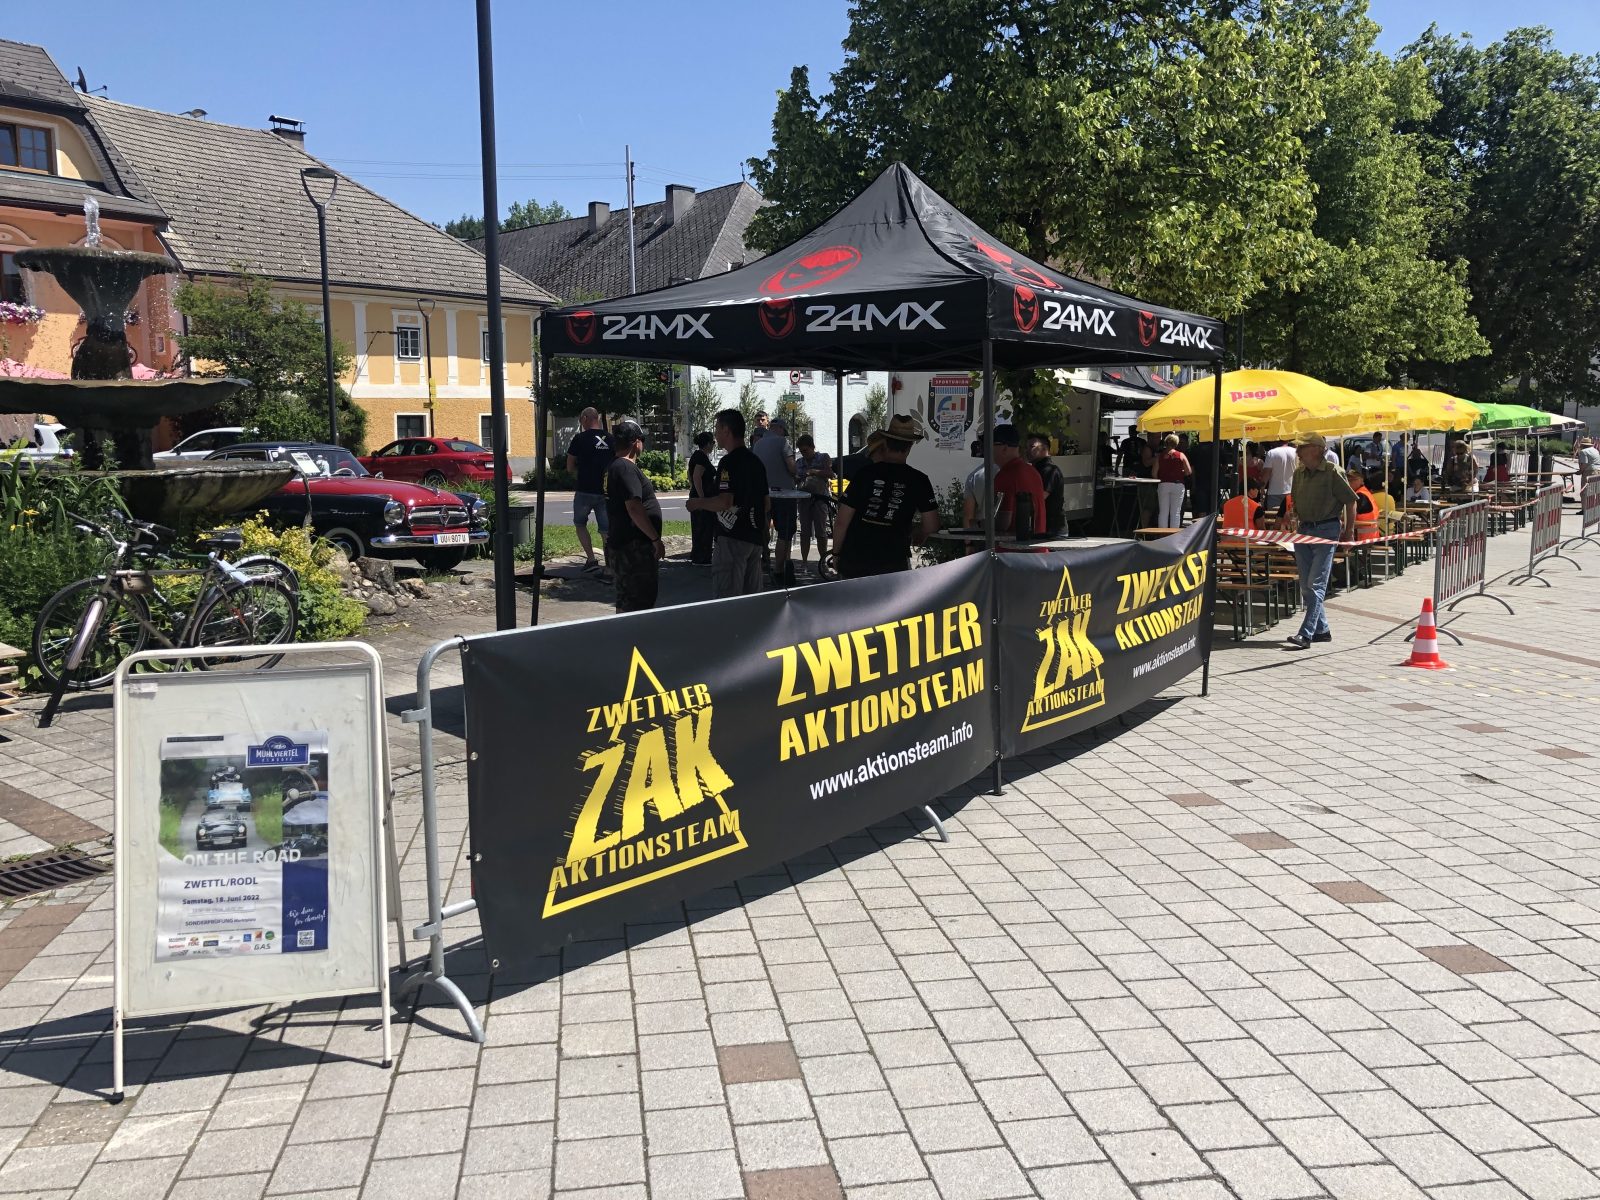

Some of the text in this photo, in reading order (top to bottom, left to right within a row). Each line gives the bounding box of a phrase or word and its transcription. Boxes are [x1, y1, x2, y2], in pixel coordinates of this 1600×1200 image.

[602, 312, 714, 341] 24MX
[805, 300, 947, 332] 24MX
[1042, 300, 1117, 337] 24MX
[1160, 319, 1214, 350] 24MX
[1229, 389, 1278, 403] pago
[1116, 549, 1209, 615] ZWETTLER
[1039, 592, 1092, 618] ZWETTLER
[765, 601, 983, 706] ZWETTLER
[1033, 609, 1105, 701] ZAK
[586, 682, 712, 733] ZWETTLER
[779, 658, 985, 762] AKTIONSTEAM
[1026, 678, 1105, 717] AKTIONSTEAM
[809, 722, 974, 800] www.aktionsteam.info
[564, 705, 734, 868] ZAK
[182, 848, 301, 867] ON THE ROAD
[548, 809, 741, 891] AKTIONSTEAM
[183, 877, 259, 890] ZWETTL/RODL
